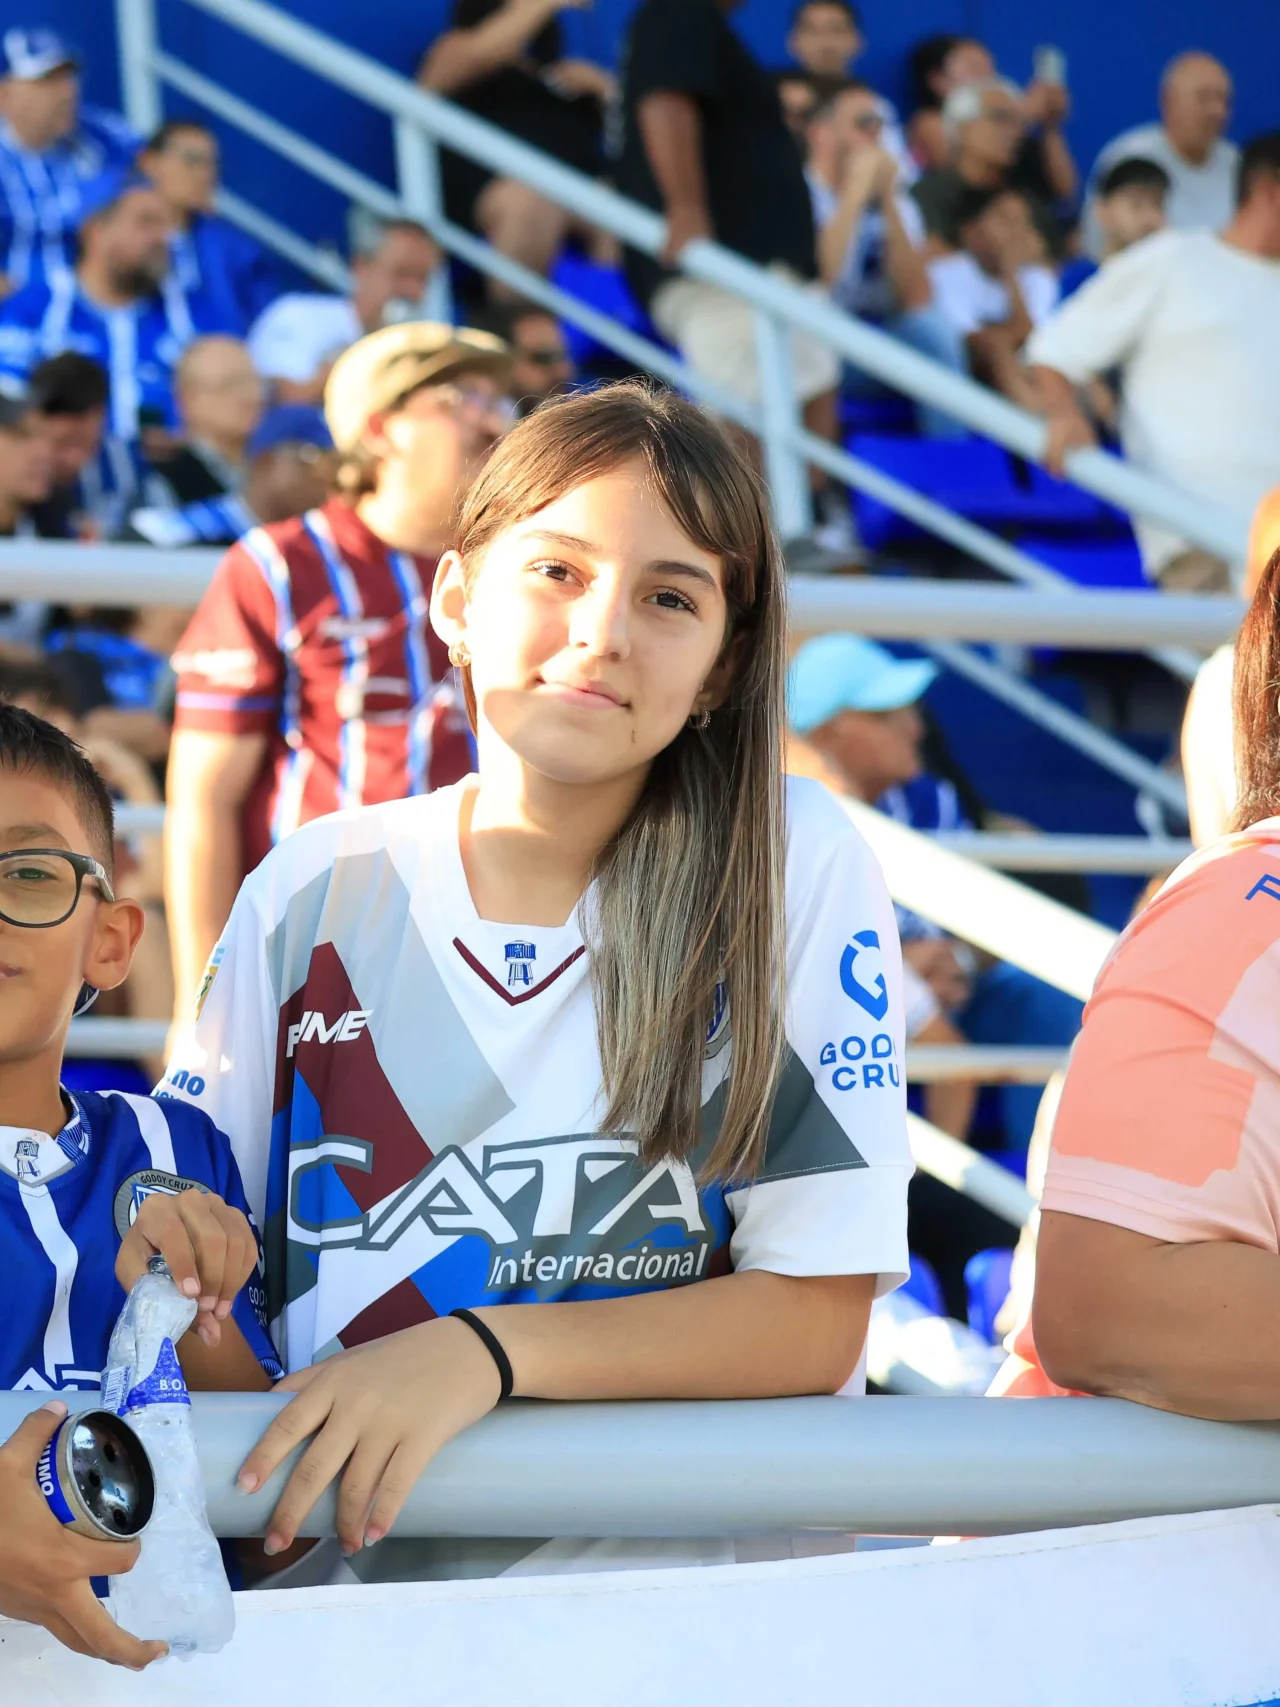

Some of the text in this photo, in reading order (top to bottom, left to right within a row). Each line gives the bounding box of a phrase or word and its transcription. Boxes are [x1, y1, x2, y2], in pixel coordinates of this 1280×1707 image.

[820, 1034, 896, 1065] GOD
[140, 1174, 167, 1185] GODOY
[286, 1137, 708, 1250] CATA
[489, 1243, 708, 1288] Internacional
